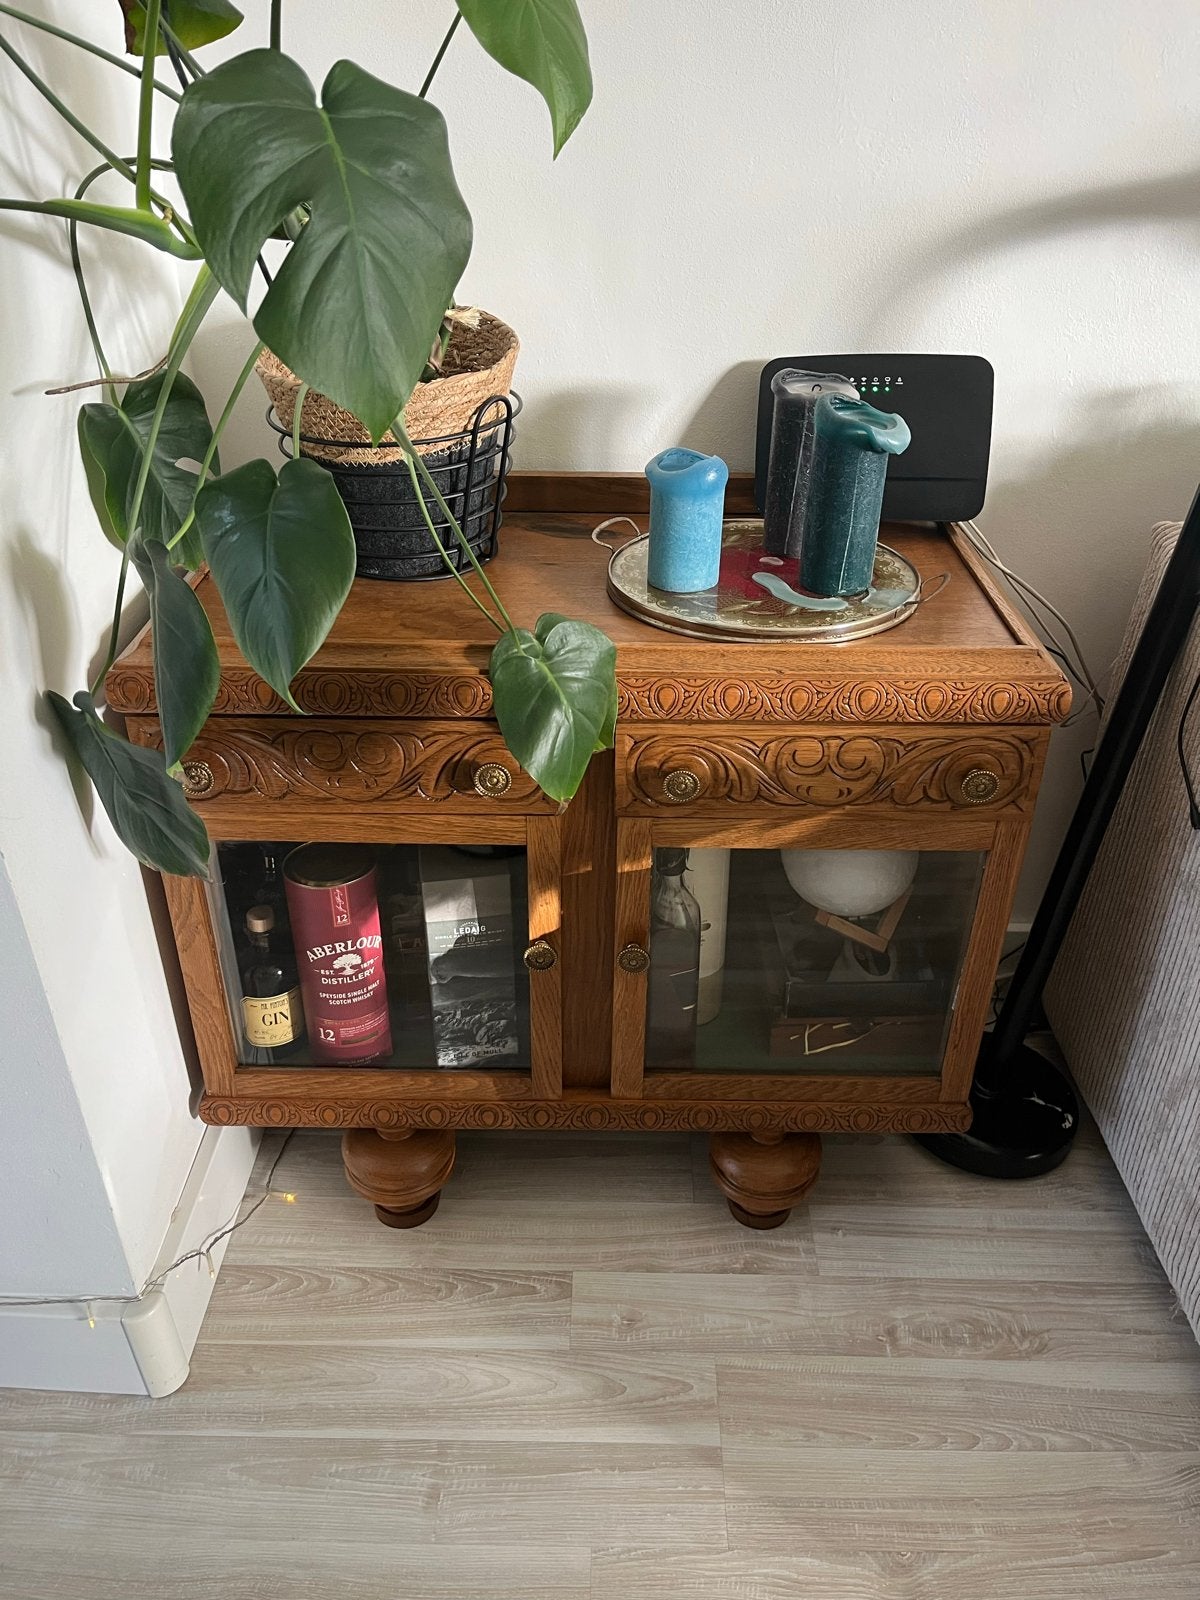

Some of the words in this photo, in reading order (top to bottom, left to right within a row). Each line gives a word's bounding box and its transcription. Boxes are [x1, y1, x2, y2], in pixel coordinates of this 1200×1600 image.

[336, 913, 348, 923] 12
[453, 925, 486, 935] LEDAIG
[306, 935, 382, 963] ABERLOUR
[321, 966, 375, 985] DISTILLERY
[347, 987, 367, 998] SINGLE
[367, 979, 380, 991] MALT
[352, 990, 374, 1003] WHISKY
[261, 1011, 289, 1026] GIN
[318, 1027, 336, 1042] 12
[483, 1048, 502, 1056] MULL
